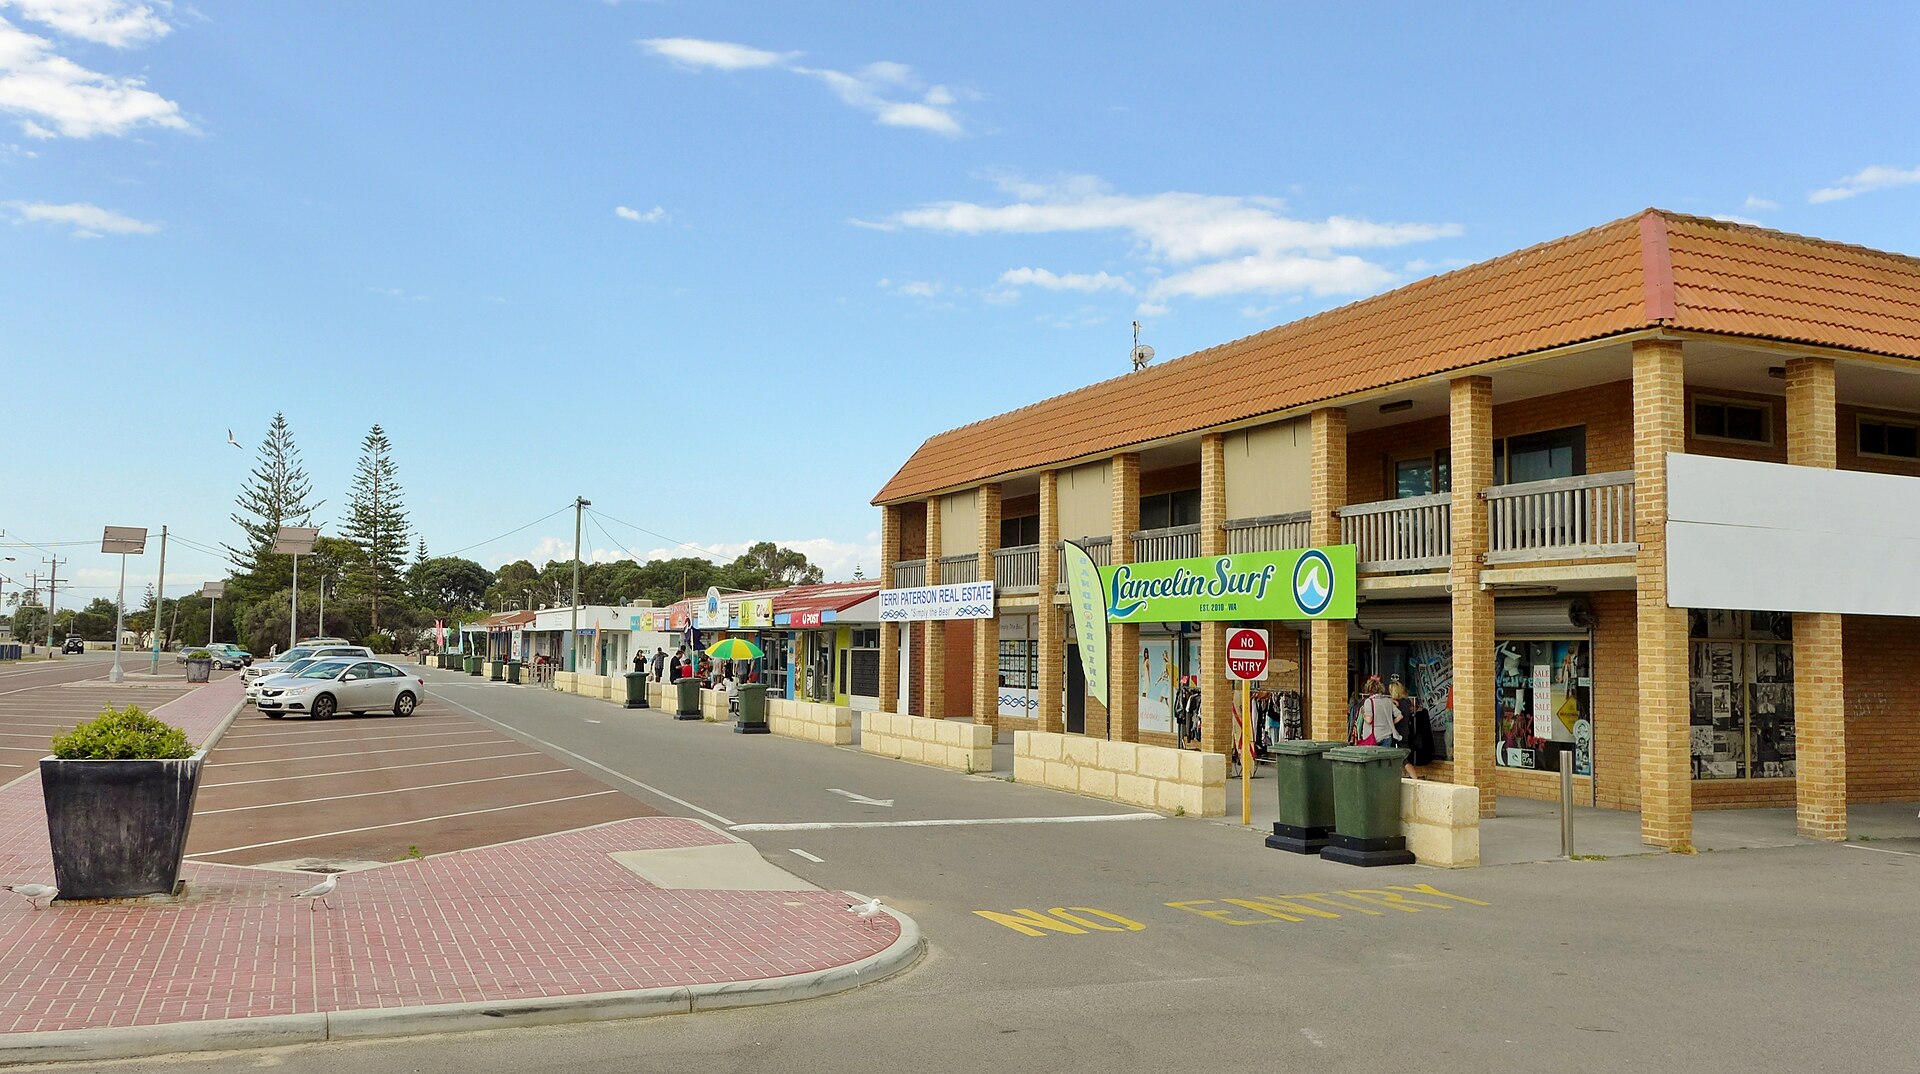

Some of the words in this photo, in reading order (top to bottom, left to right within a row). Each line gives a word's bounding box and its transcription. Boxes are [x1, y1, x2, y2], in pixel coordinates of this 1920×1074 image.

[1107, 565, 1205, 618] Lancelin
[1208, 557, 1276, 601] Surf
[880, 592, 899, 606] TERRI
[901, 589, 937, 605] PATERSON
[940, 588, 959, 603] REAL
[962, 585, 992, 602] ESTATE
[1241, 637, 1254, 648] NO
[1232, 661, 1262, 672] ENTRY
[1535, 703, 1550, 711] SALE
[1535, 714, 1550, 722] SALE
[1535, 725, 1551, 733] SALE
[972, 906, 1147, 938] NO
[1163, 883, 1492, 926] ENTRY
